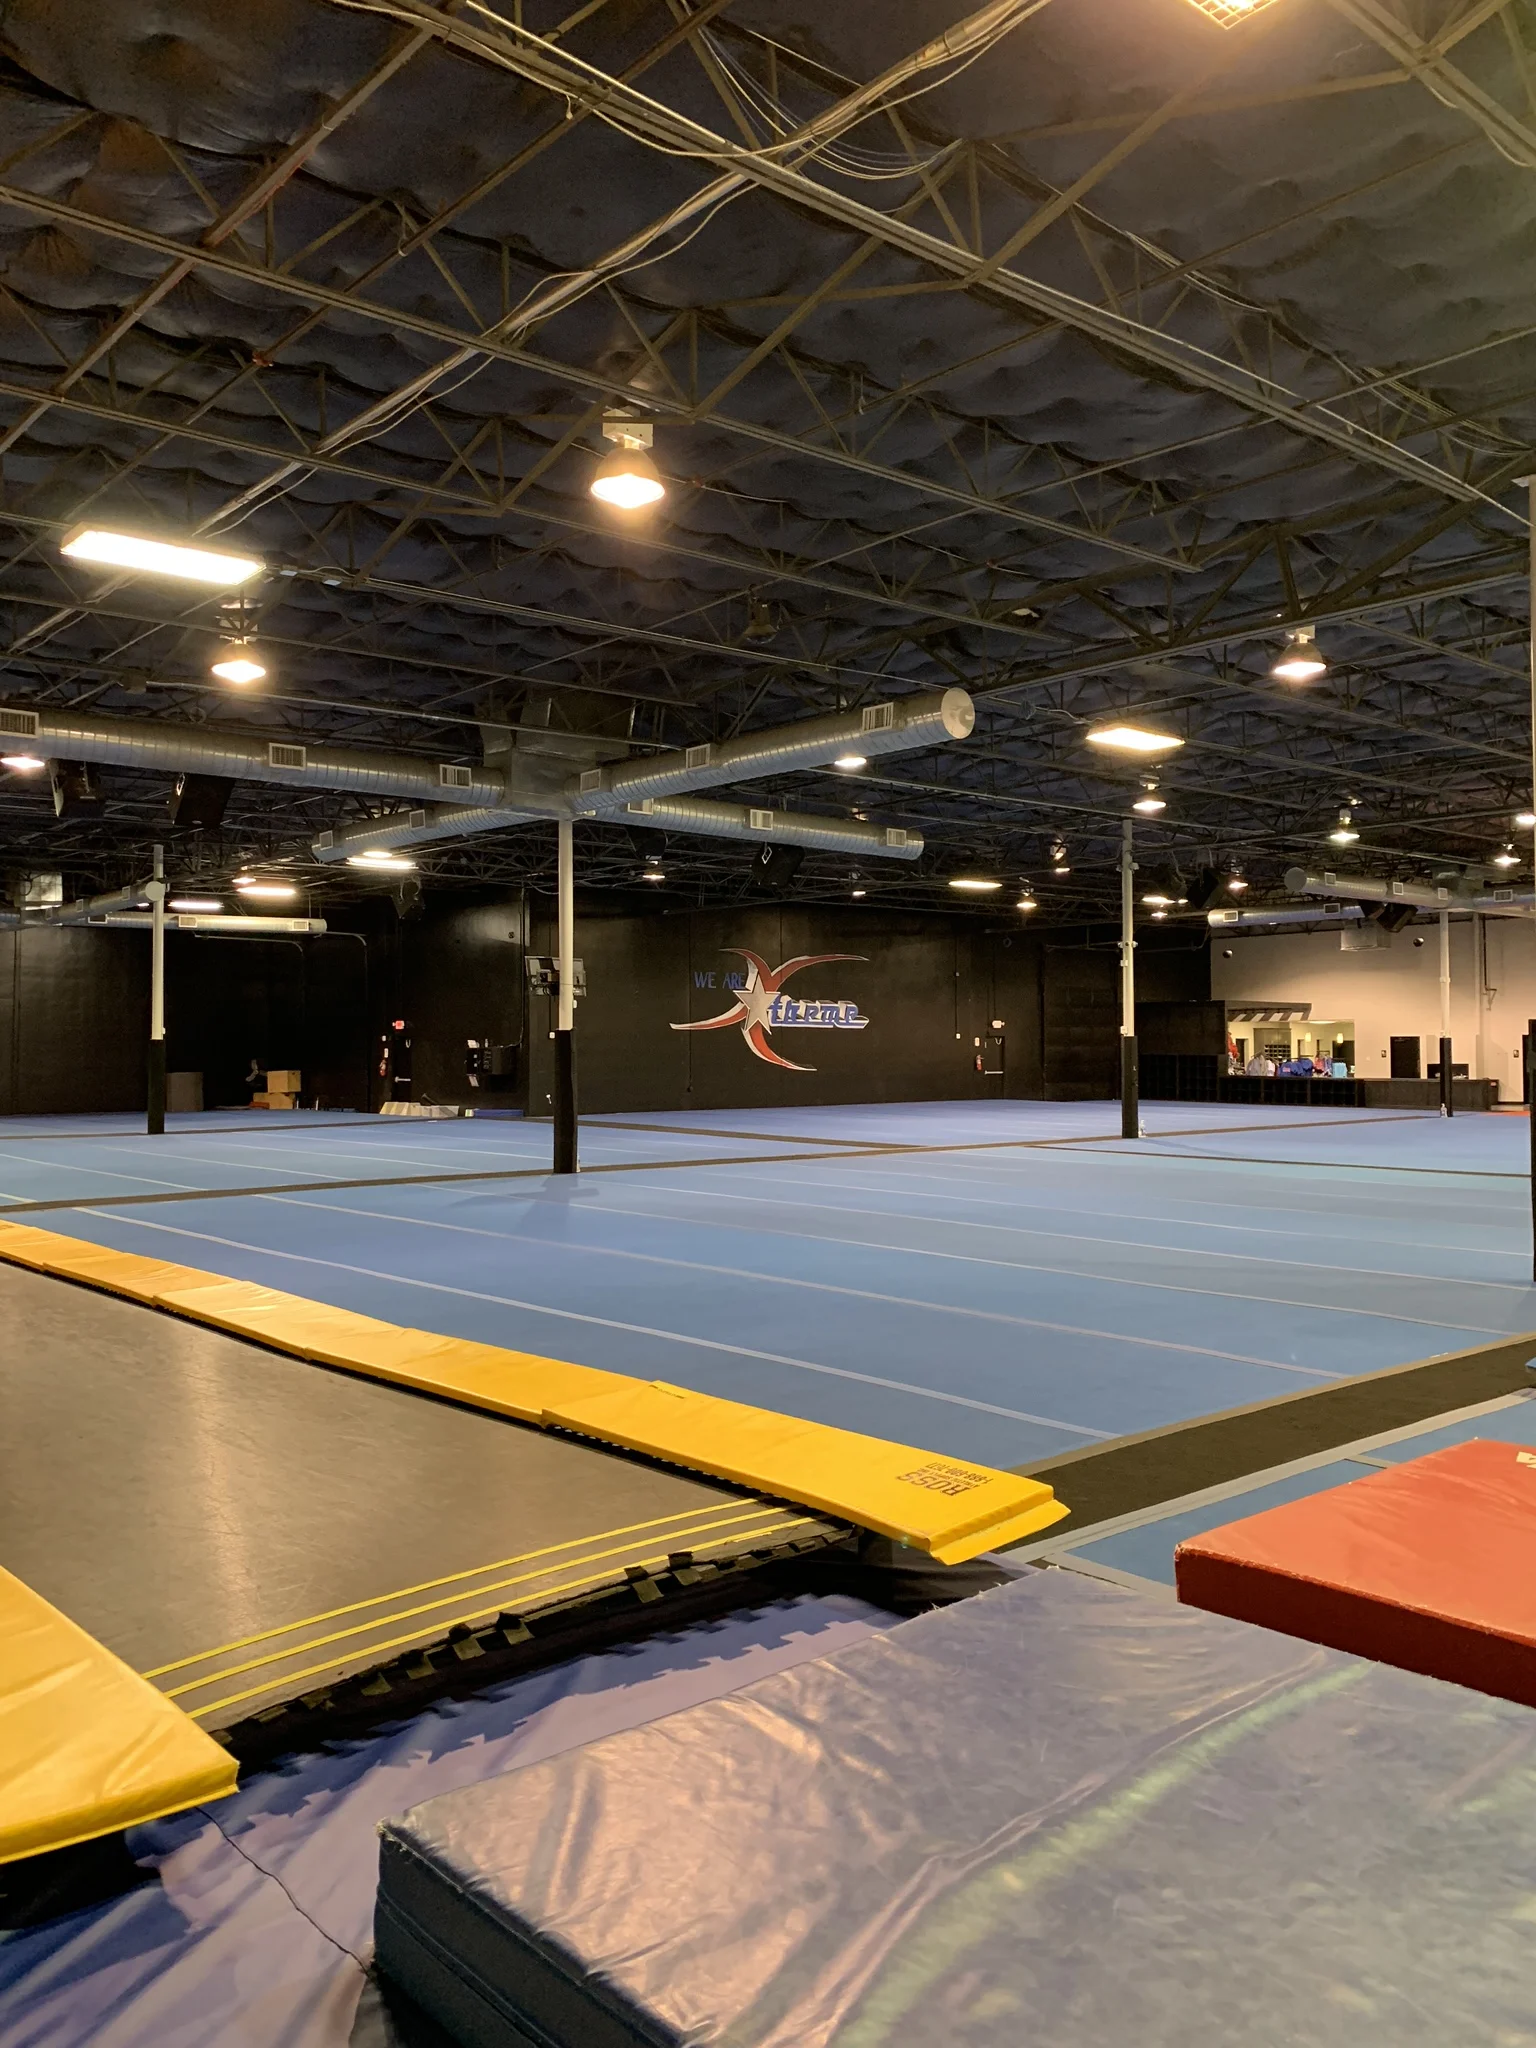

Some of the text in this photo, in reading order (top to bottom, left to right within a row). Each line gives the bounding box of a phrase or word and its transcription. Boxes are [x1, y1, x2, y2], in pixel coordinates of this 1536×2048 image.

[694, 971, 746, 990] WE ARE
[896, 1472, 970, 1496] ROSS
